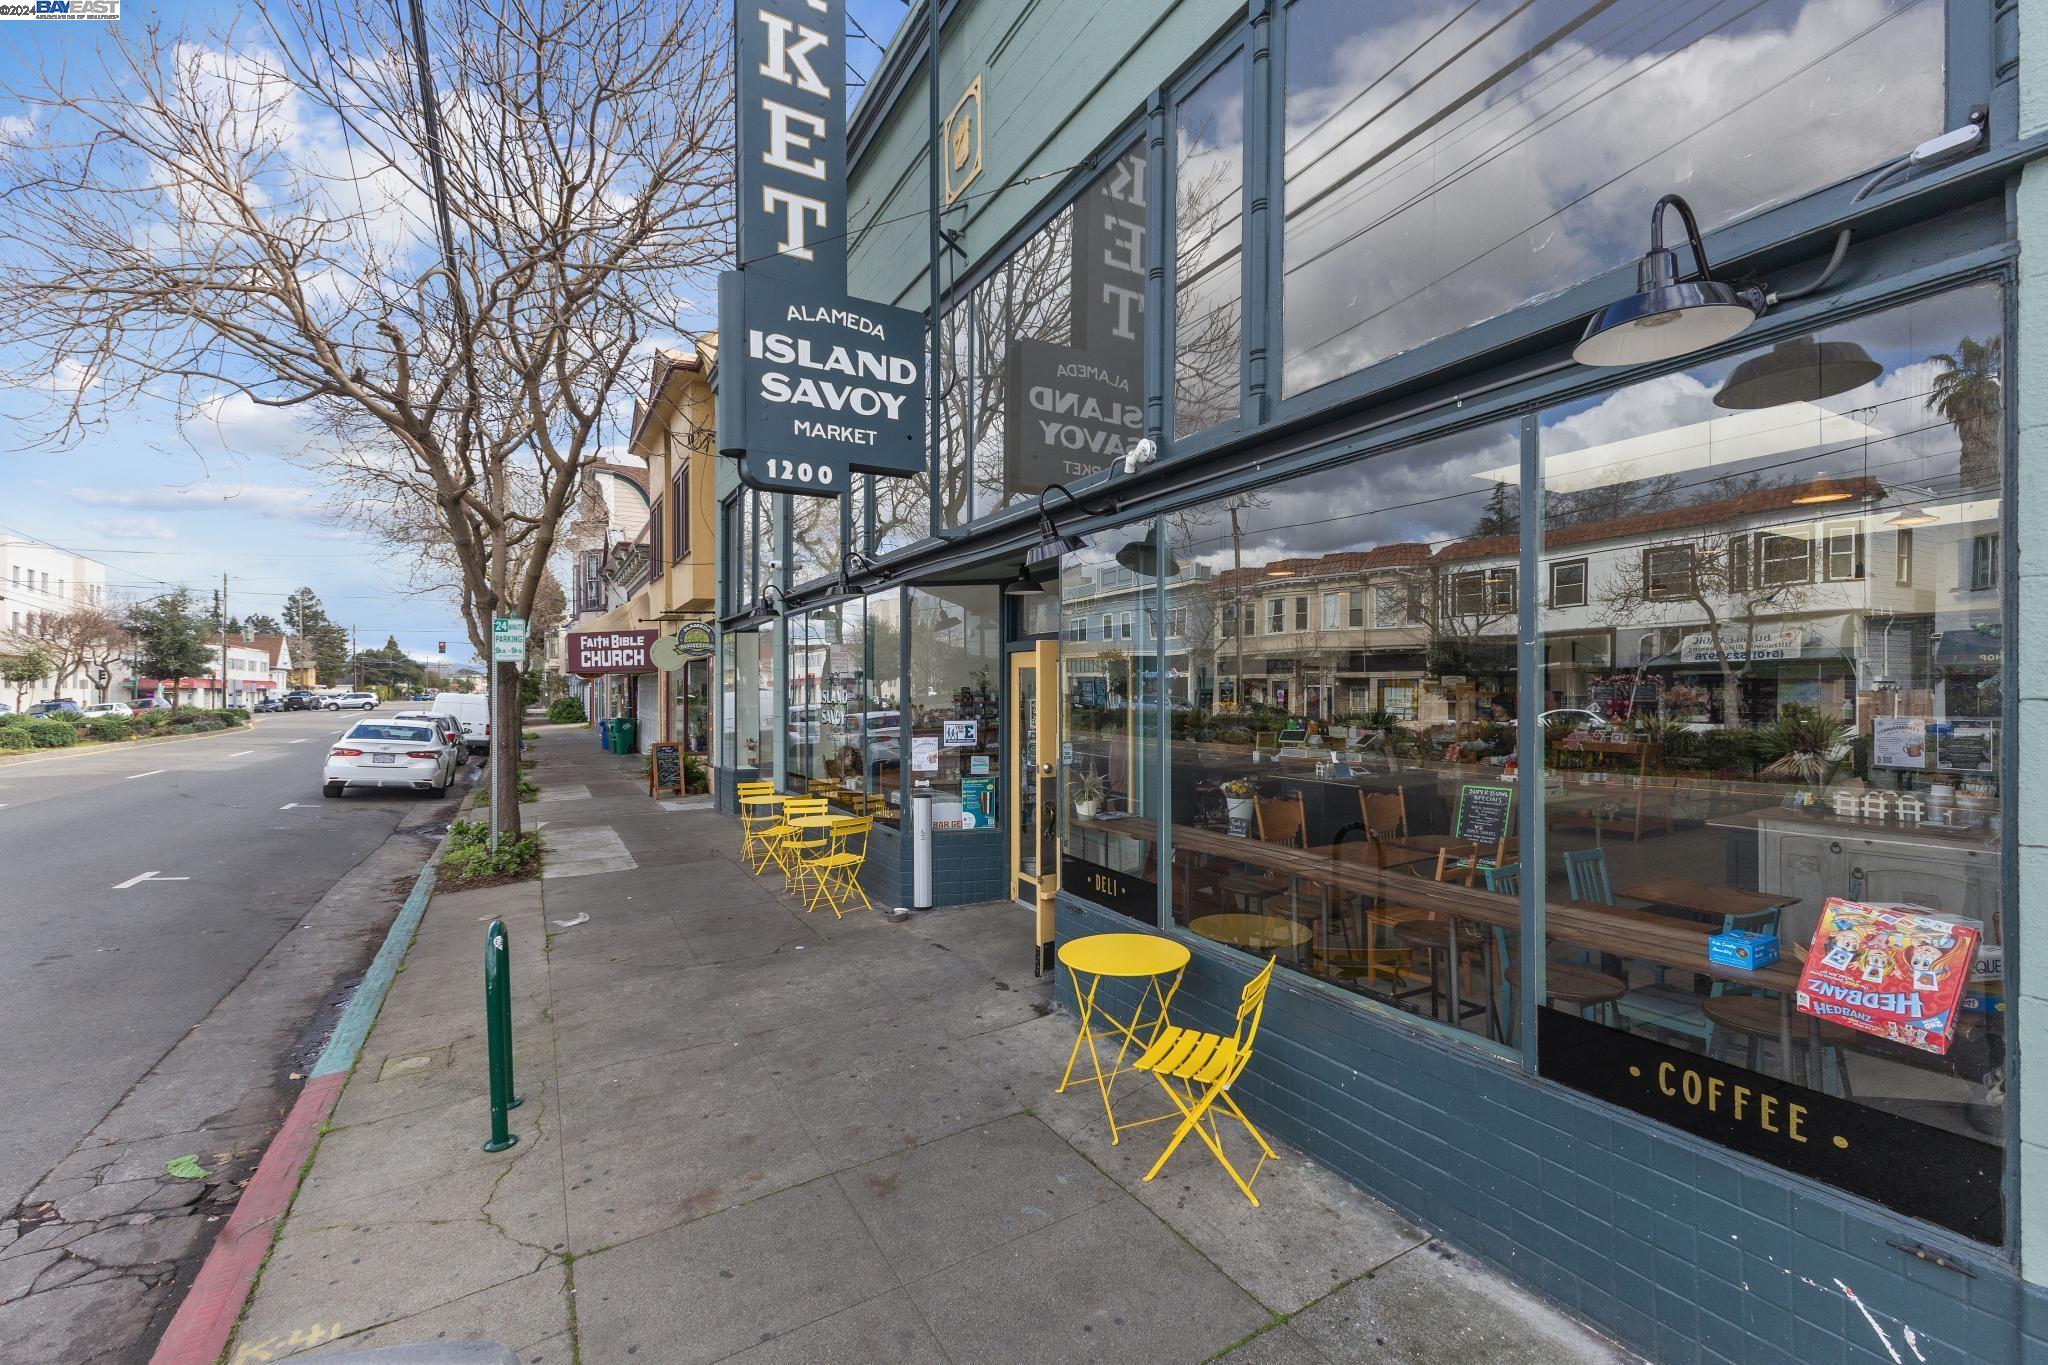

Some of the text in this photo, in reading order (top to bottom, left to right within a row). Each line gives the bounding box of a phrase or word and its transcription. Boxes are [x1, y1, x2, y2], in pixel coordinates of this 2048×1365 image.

[787, 305, 885, 341] ALAMEDA
[750, 329, 917, 385] ISLAND
[760, 372, 907, 420] SAVOY
[794, 419, 877, 446] MARKET
[767, 459, 833, 485] 1200
[495, 620, 507, 631] 24
[683, 623, 711, 633] ALAMEDA
[496, 635, 523, 643] PARKING
[610, 634, 645, 649] BIBLE
[581, 649, 645, 667] CHURCH
[1469, 788, 1489, 796] SUPER
[1095, 873, 1117, 897] DELI
[1808, 978, 1924, 1018] HEDBANZ
[1813, 1000, 1873, 1023] HEDBANZ
[1658, 1061, 1808, 1143] COFFEE
